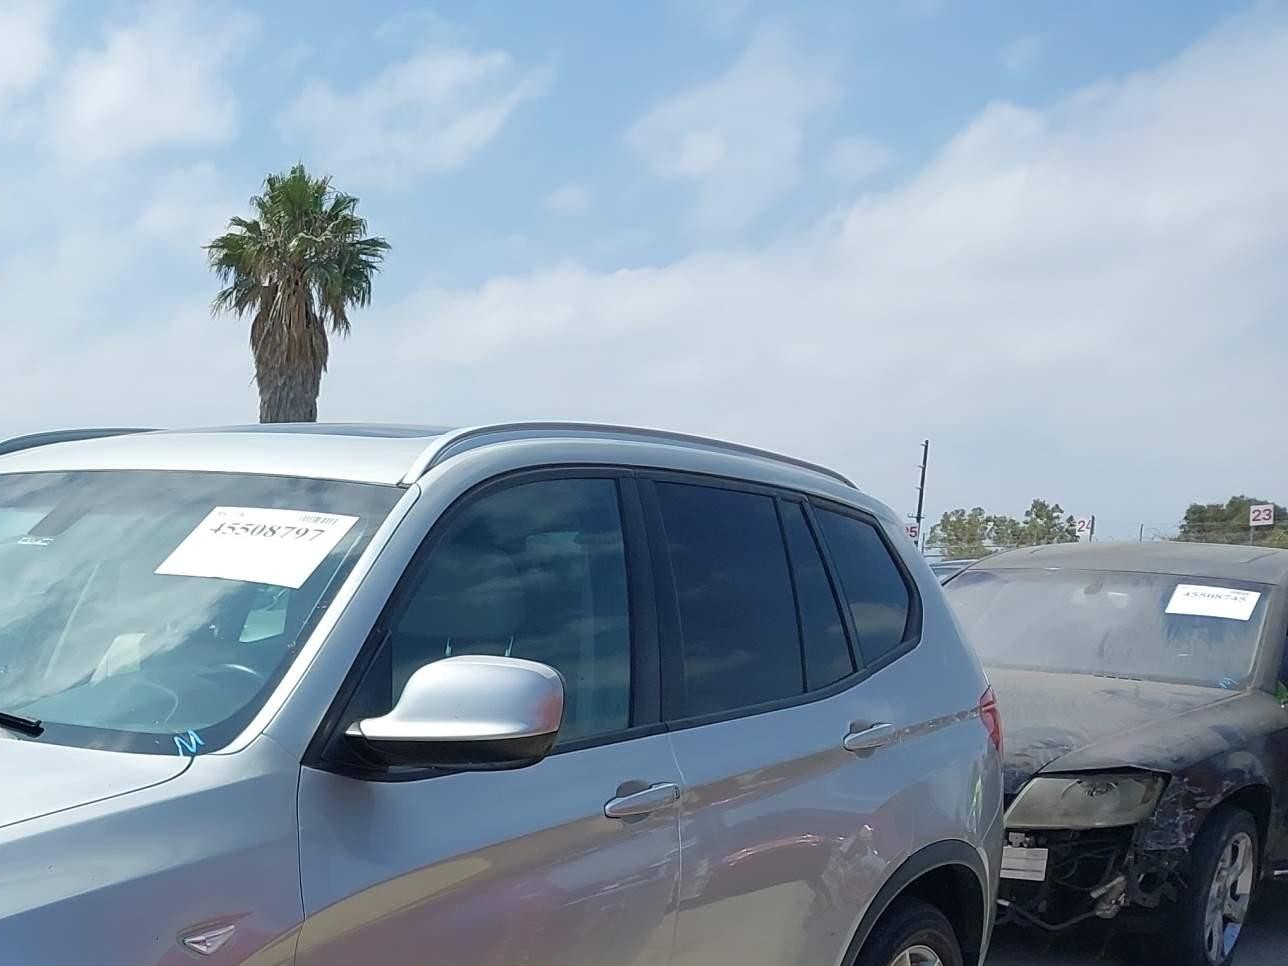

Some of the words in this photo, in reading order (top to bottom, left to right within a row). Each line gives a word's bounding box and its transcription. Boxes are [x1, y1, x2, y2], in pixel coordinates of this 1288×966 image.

[1252, 509, 1273, 522] 23
[210, 521, 326, 541] 45508797
[905, 526, 918, 538] 5
